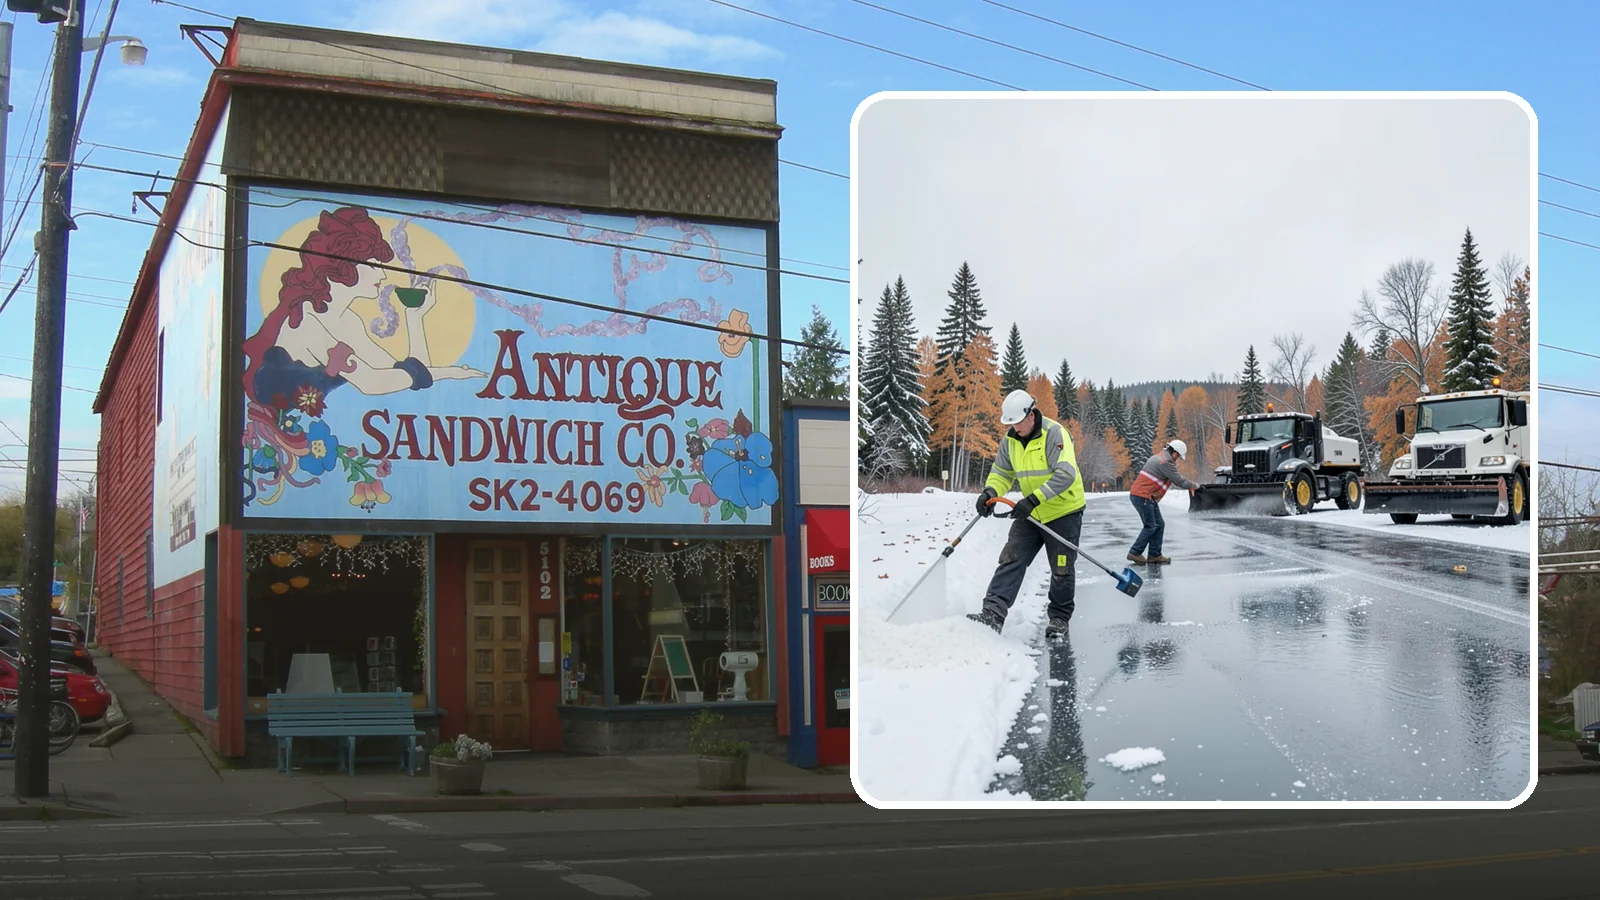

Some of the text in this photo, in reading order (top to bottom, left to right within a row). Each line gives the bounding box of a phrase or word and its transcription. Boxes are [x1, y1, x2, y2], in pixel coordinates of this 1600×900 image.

[475, 328, 724, 421] ANTIQUE
[361, 408, 684, 469] SANDWICH CO.
[468, 477, 645, 512] SK2-4069
[540, 541, 551, 600] 5102
[809, 554, 835, 569] BOOKS
